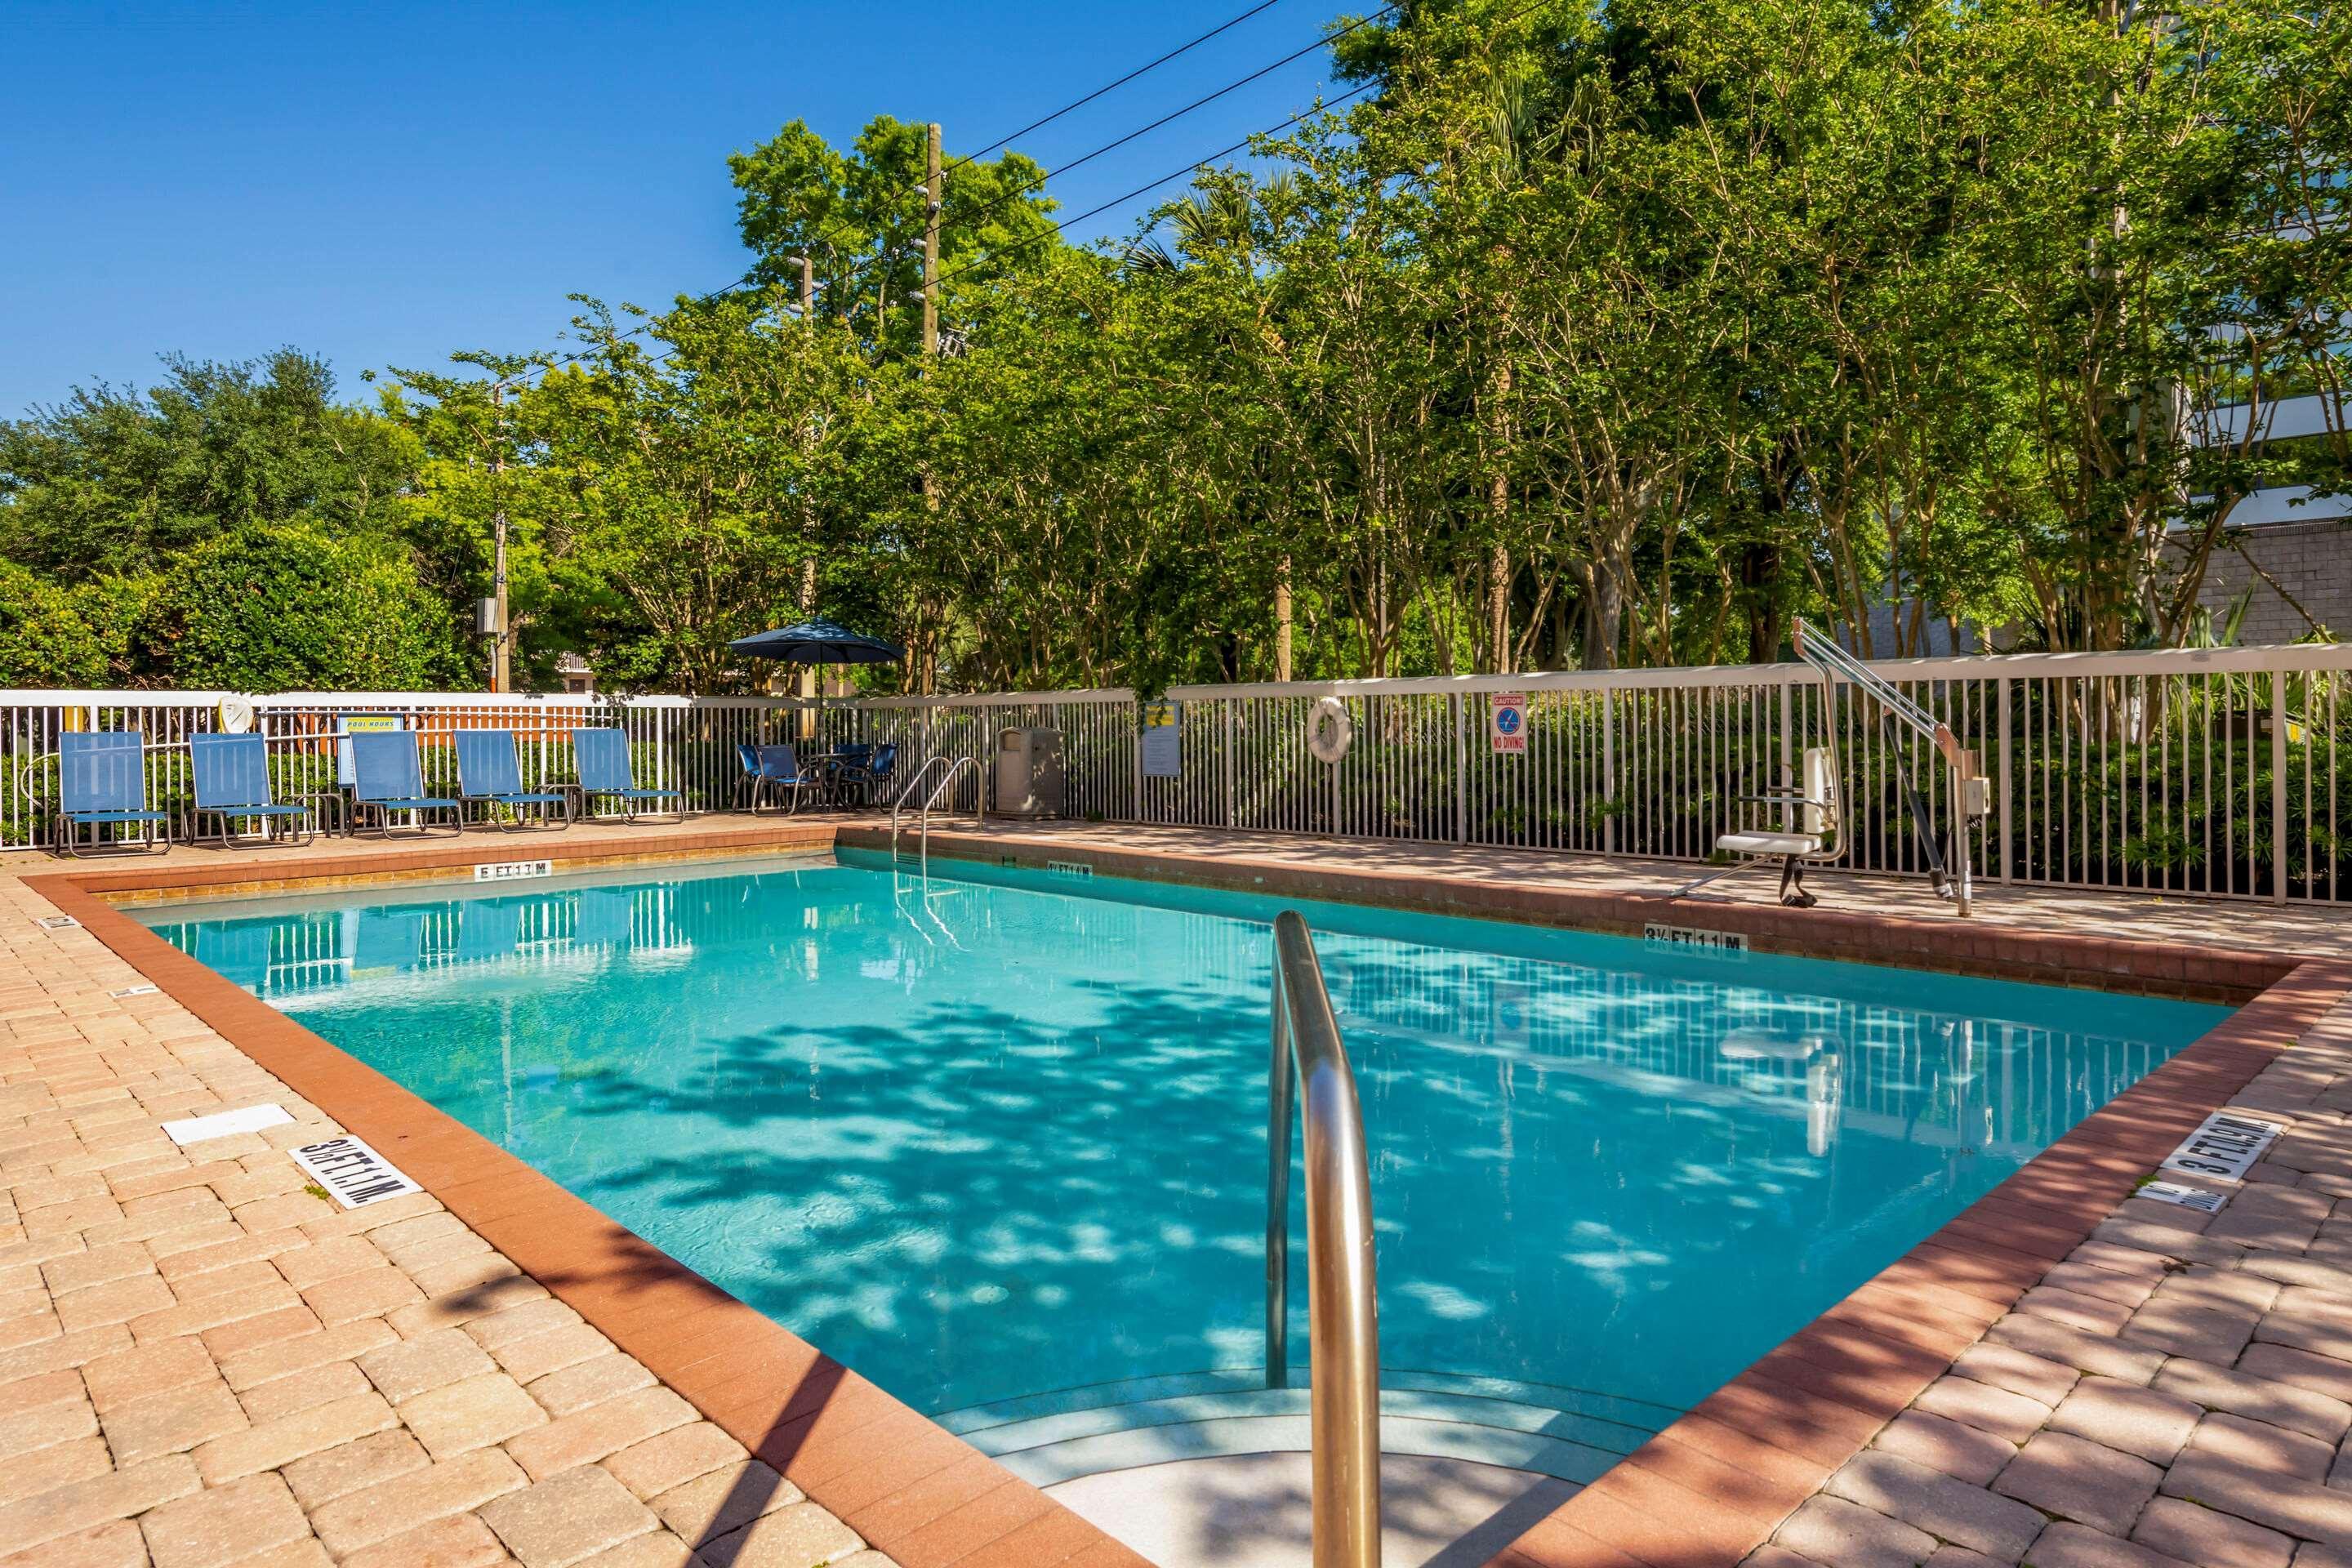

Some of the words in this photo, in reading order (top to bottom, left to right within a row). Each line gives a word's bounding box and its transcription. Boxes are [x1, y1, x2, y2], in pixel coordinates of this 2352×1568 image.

[1494, 736, 1502, 749] NO
[1725, 936, 1740, 950] M
[2201, 1127, 2261, 1147] 0.9
[2177, 1159, 2231, 1174] 3
[330, 1166, 392, 1189] 1.1
